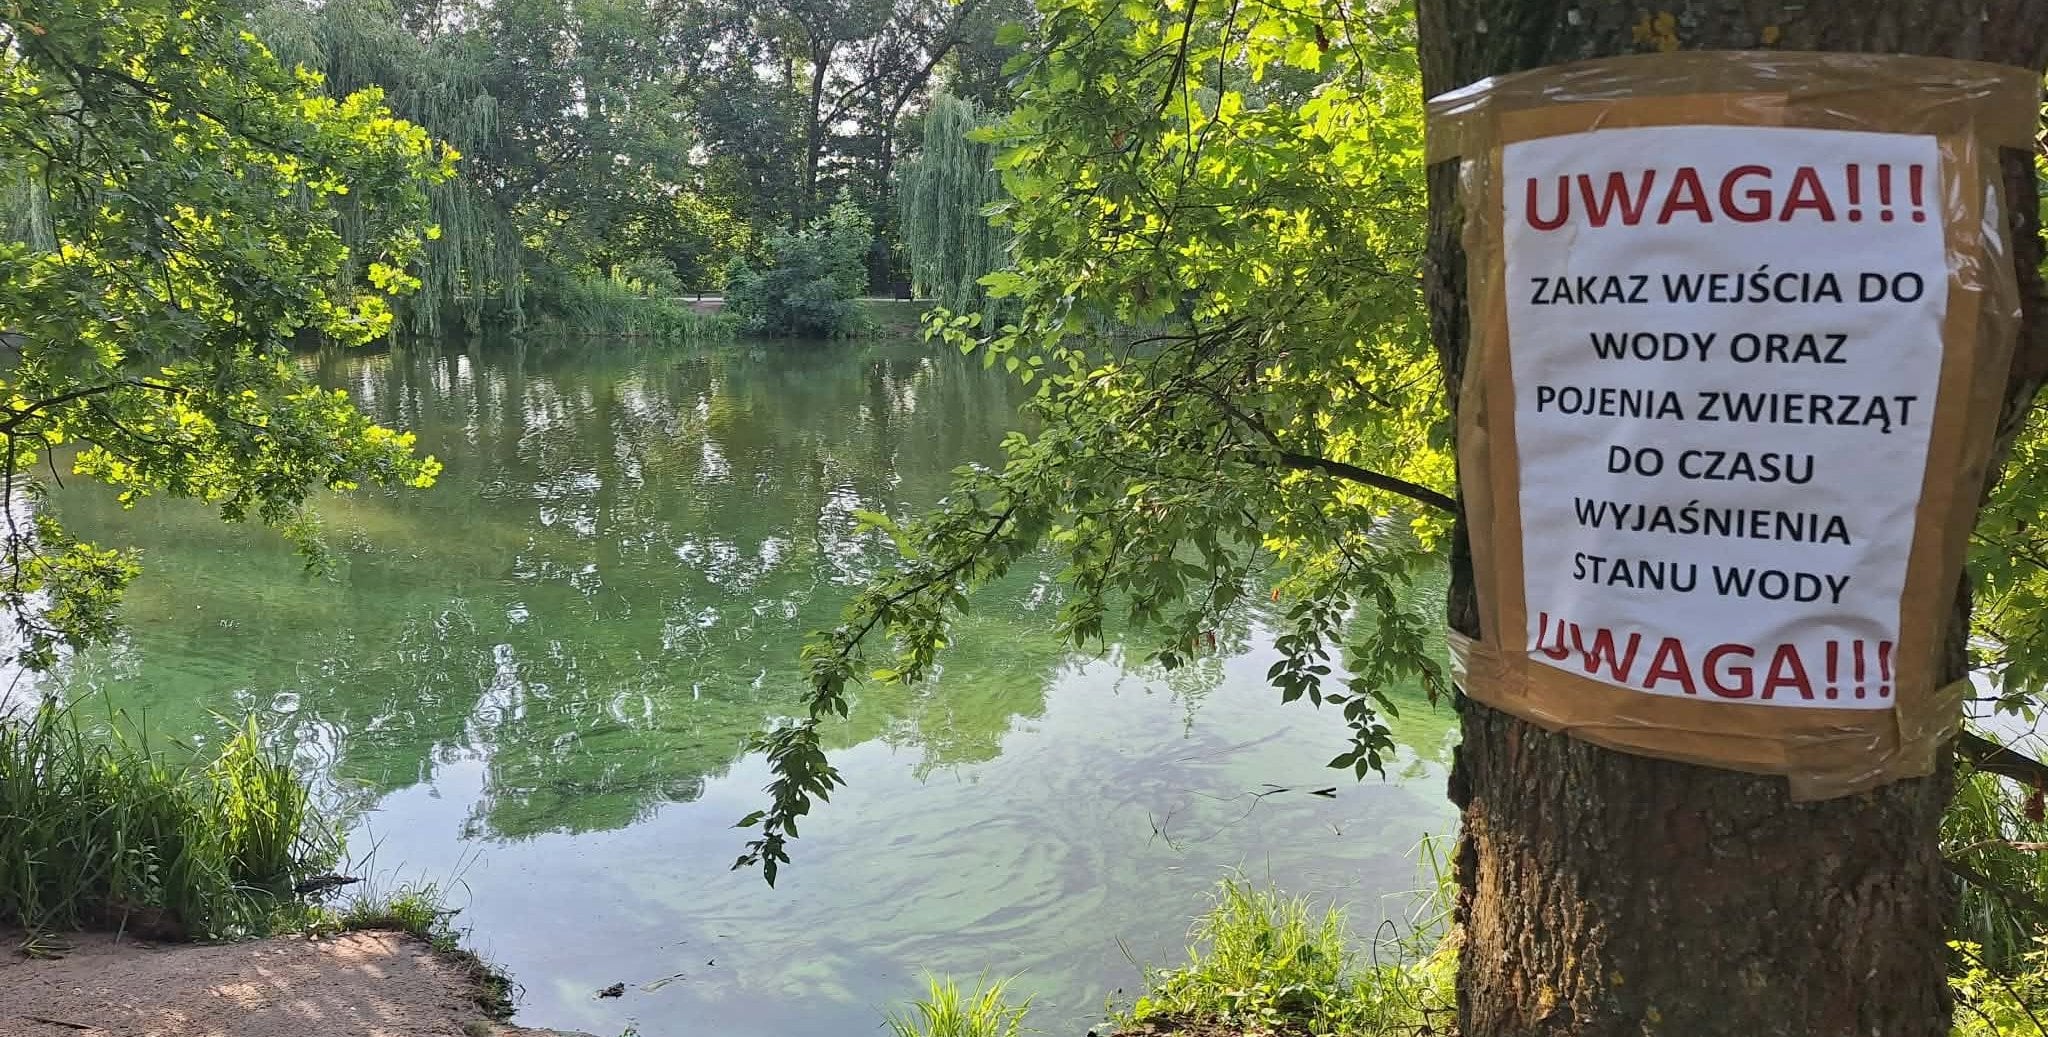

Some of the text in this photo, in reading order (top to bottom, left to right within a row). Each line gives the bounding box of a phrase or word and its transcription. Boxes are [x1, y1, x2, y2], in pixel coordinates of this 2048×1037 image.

[1525, 163, 1927, 231] UWAGA!!!
[1530, 264, 1925, 305] ZAKAZ WEJŚCIA DO
[1590, 332, 1849, 364] WODY ORAZ
[1536, 385, 1918, 434] POJENIA ZWIERZĄT
[1608, 445, 1815, 484] DO CZASU
[1574, 497, 1851, 545] WYJAŚNIENIA
[1572, 552, 1850, 604] STANU WODY
[1536, 612, 1894, 700] UWAGA!!!
